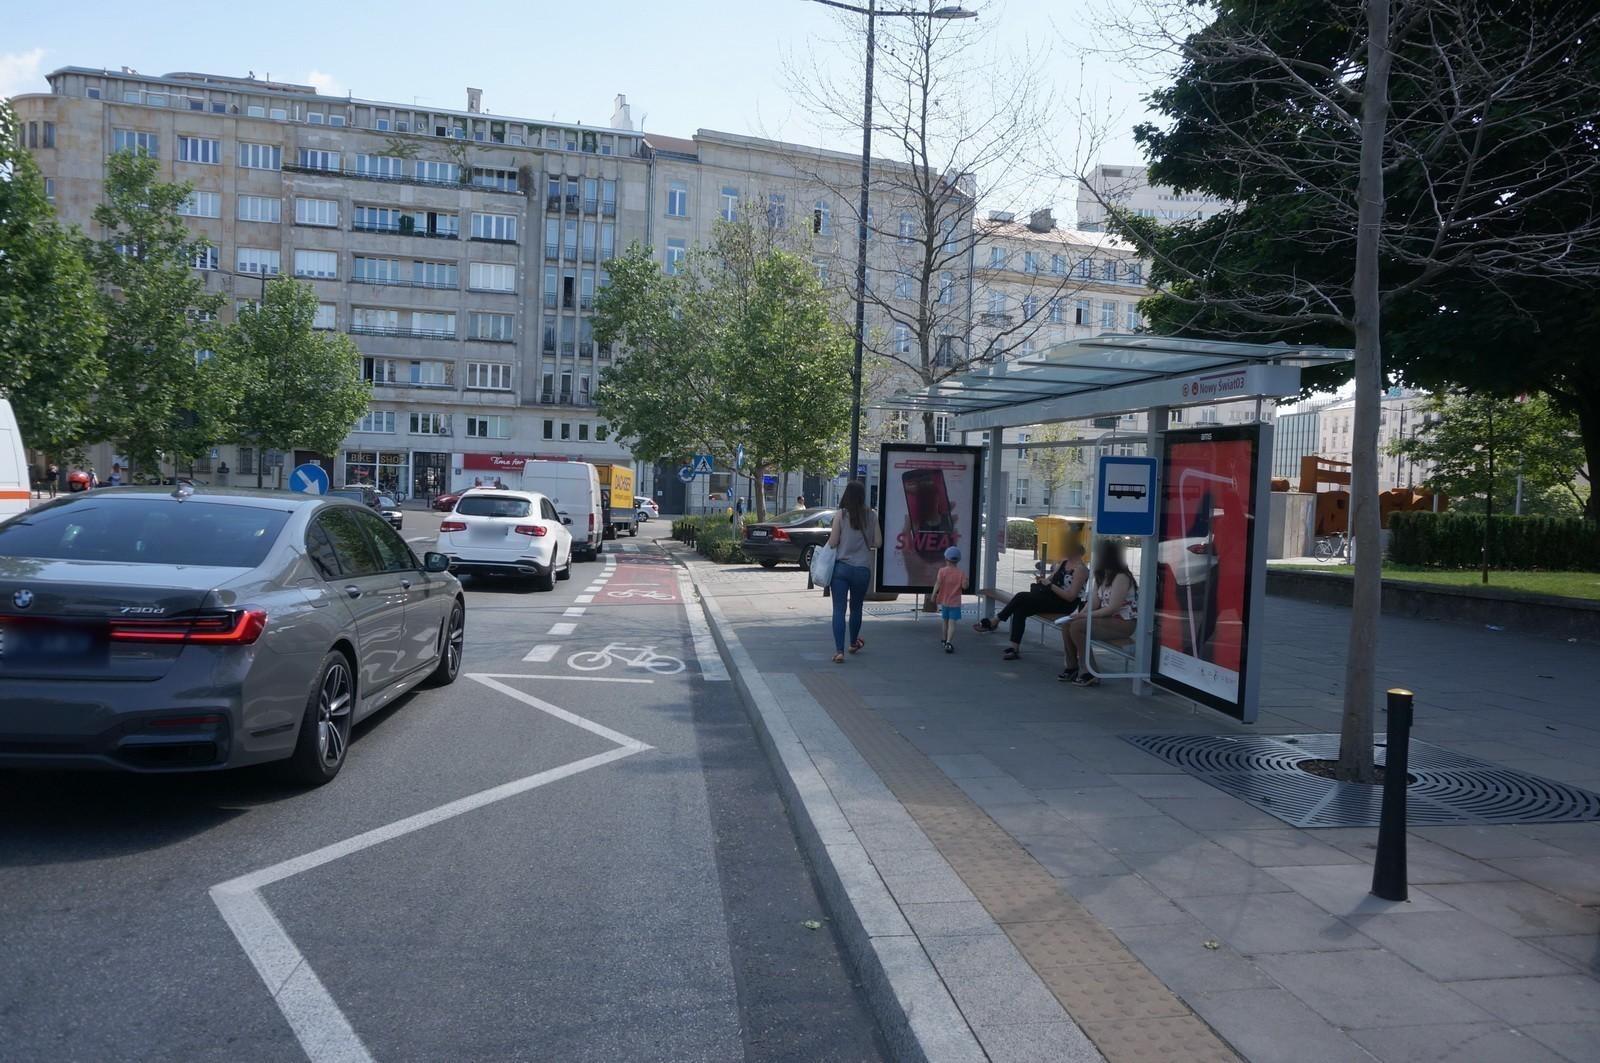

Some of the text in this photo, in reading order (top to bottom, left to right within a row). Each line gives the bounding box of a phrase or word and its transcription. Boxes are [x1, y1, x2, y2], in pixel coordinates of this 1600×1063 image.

[1200, 382, 1217, 395] Nowy
[351, 453, 406, 464] BIKE SHOP
[490, 456, 511, 466] Time
[511, 458, 524, 466] for
